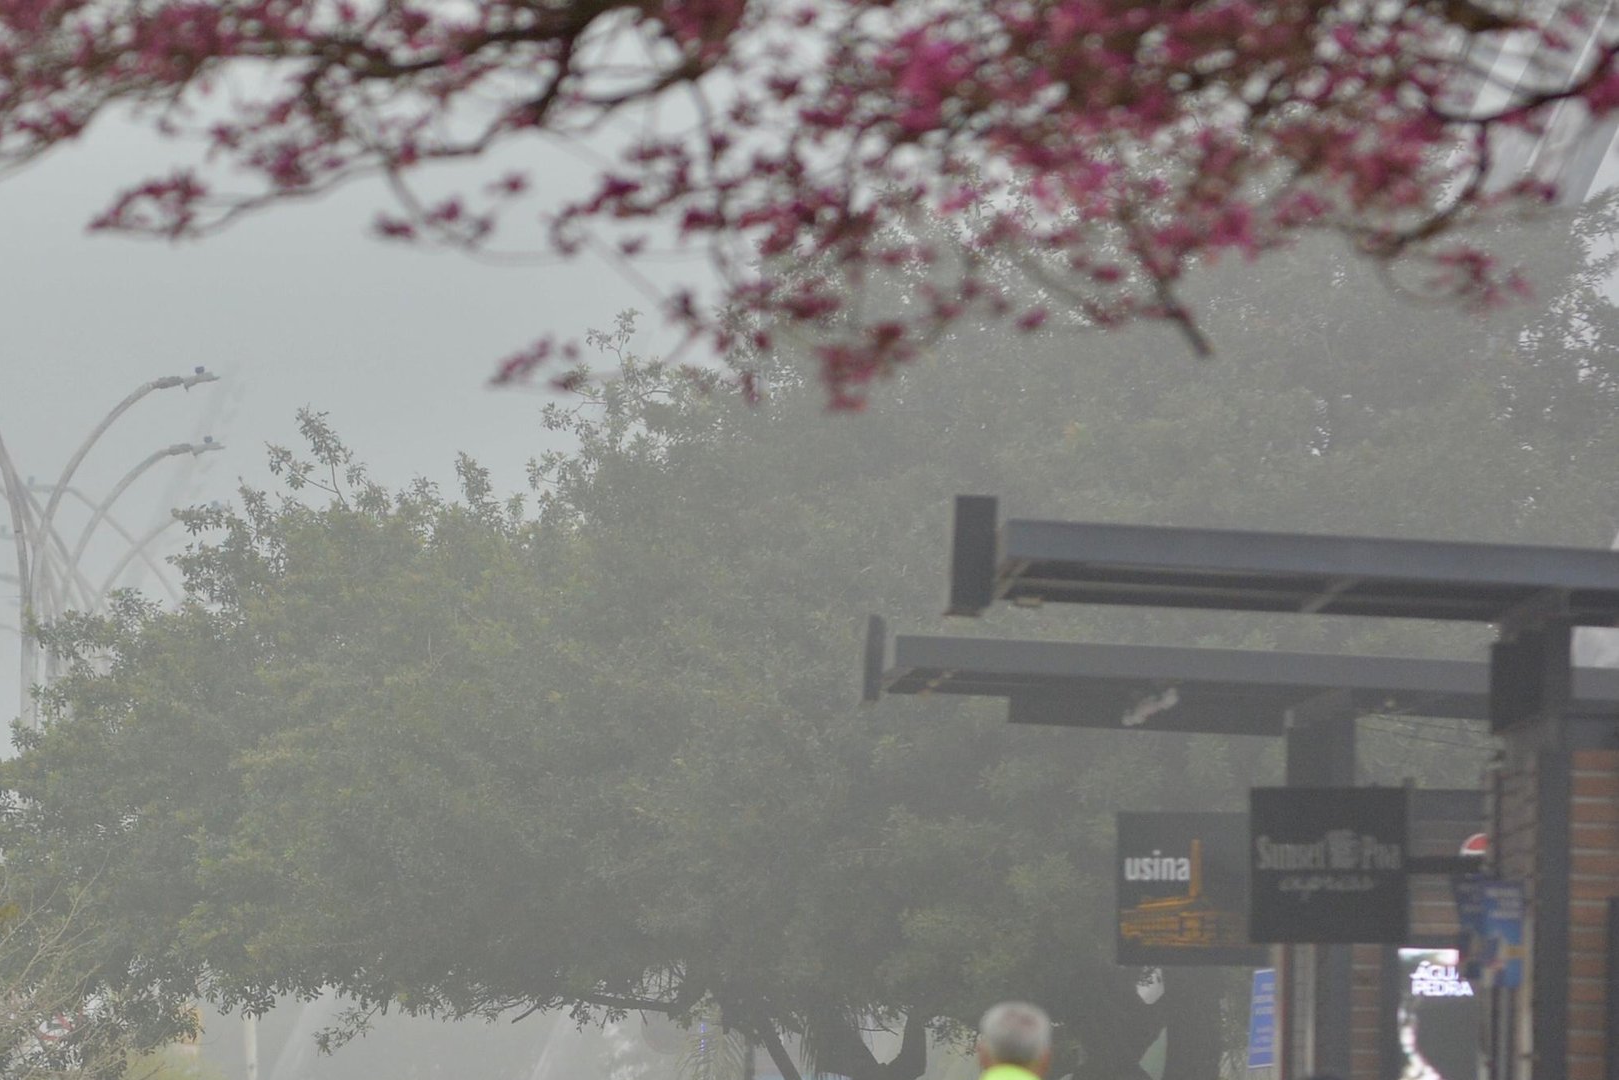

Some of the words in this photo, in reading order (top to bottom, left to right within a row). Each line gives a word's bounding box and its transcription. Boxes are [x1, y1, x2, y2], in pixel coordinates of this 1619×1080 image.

[1124, 849, 1191, 881] usina
[1255, 834, 1326, 870] Sunset
[1411, 979, 1474, 997] PEDRA
